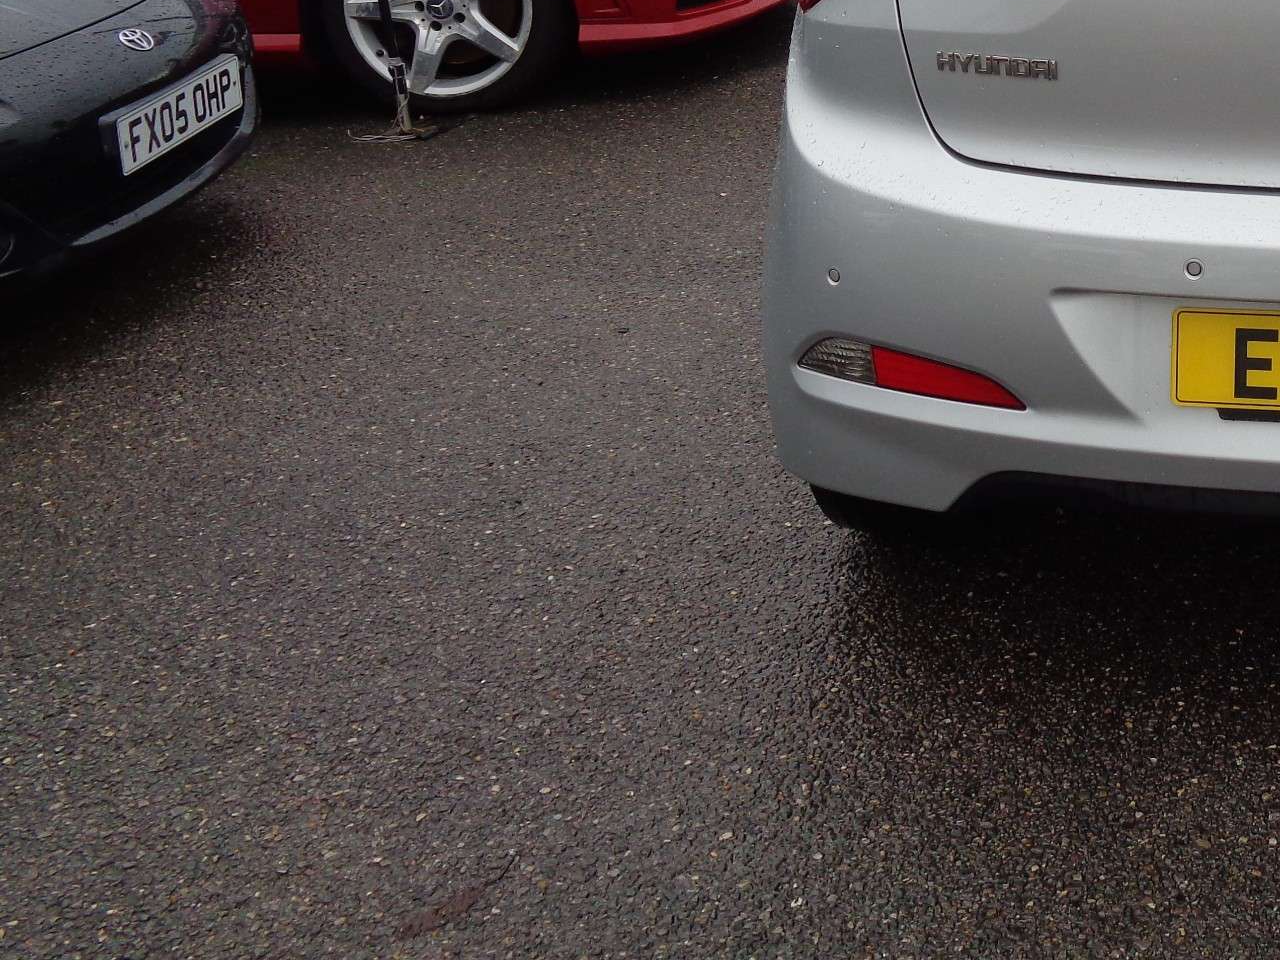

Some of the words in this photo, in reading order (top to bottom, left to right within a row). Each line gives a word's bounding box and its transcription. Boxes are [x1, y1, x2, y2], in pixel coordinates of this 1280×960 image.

[937, 51, 1058, 80] HYUNDAI
[128, 92, 188, 163] FX05
[193, 68, 231, 123] OHP
